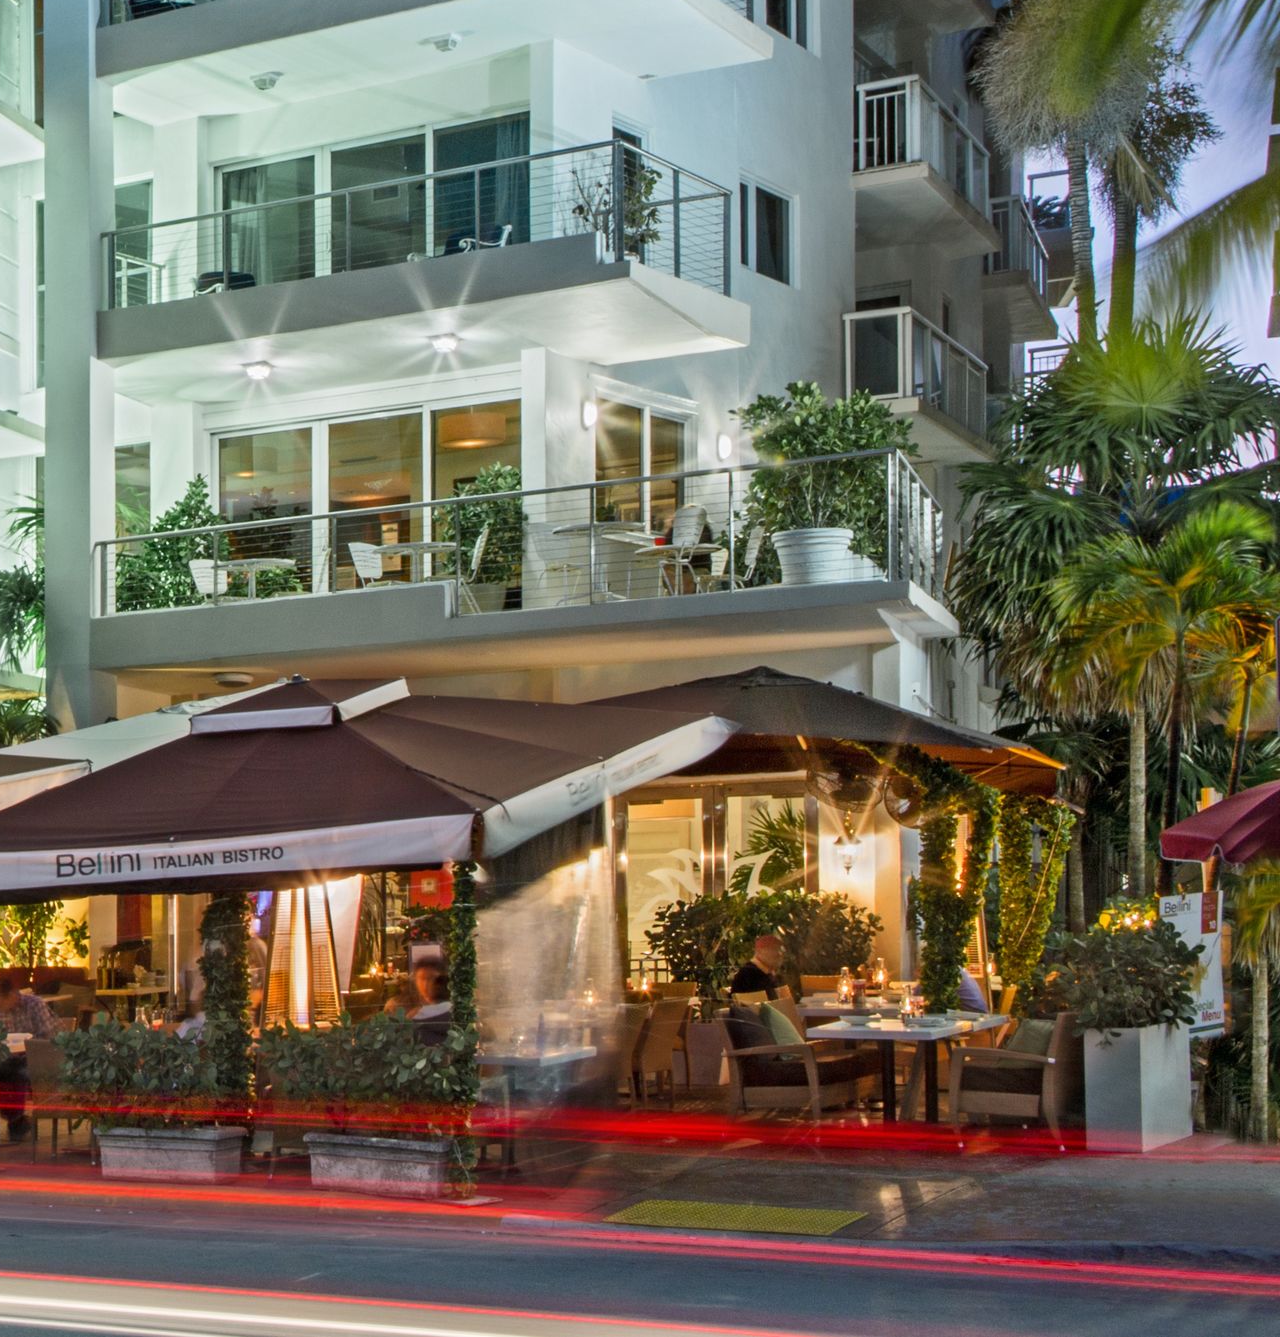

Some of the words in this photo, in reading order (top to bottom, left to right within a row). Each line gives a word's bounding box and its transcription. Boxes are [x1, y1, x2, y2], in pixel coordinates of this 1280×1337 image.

[56, 851, 141, 878] Bellini
[153, 852, 214, 870] ITALIAN
[223, 846, 284, 864] BISTRO
[1202, 1010, 1222, 1022] Menu
